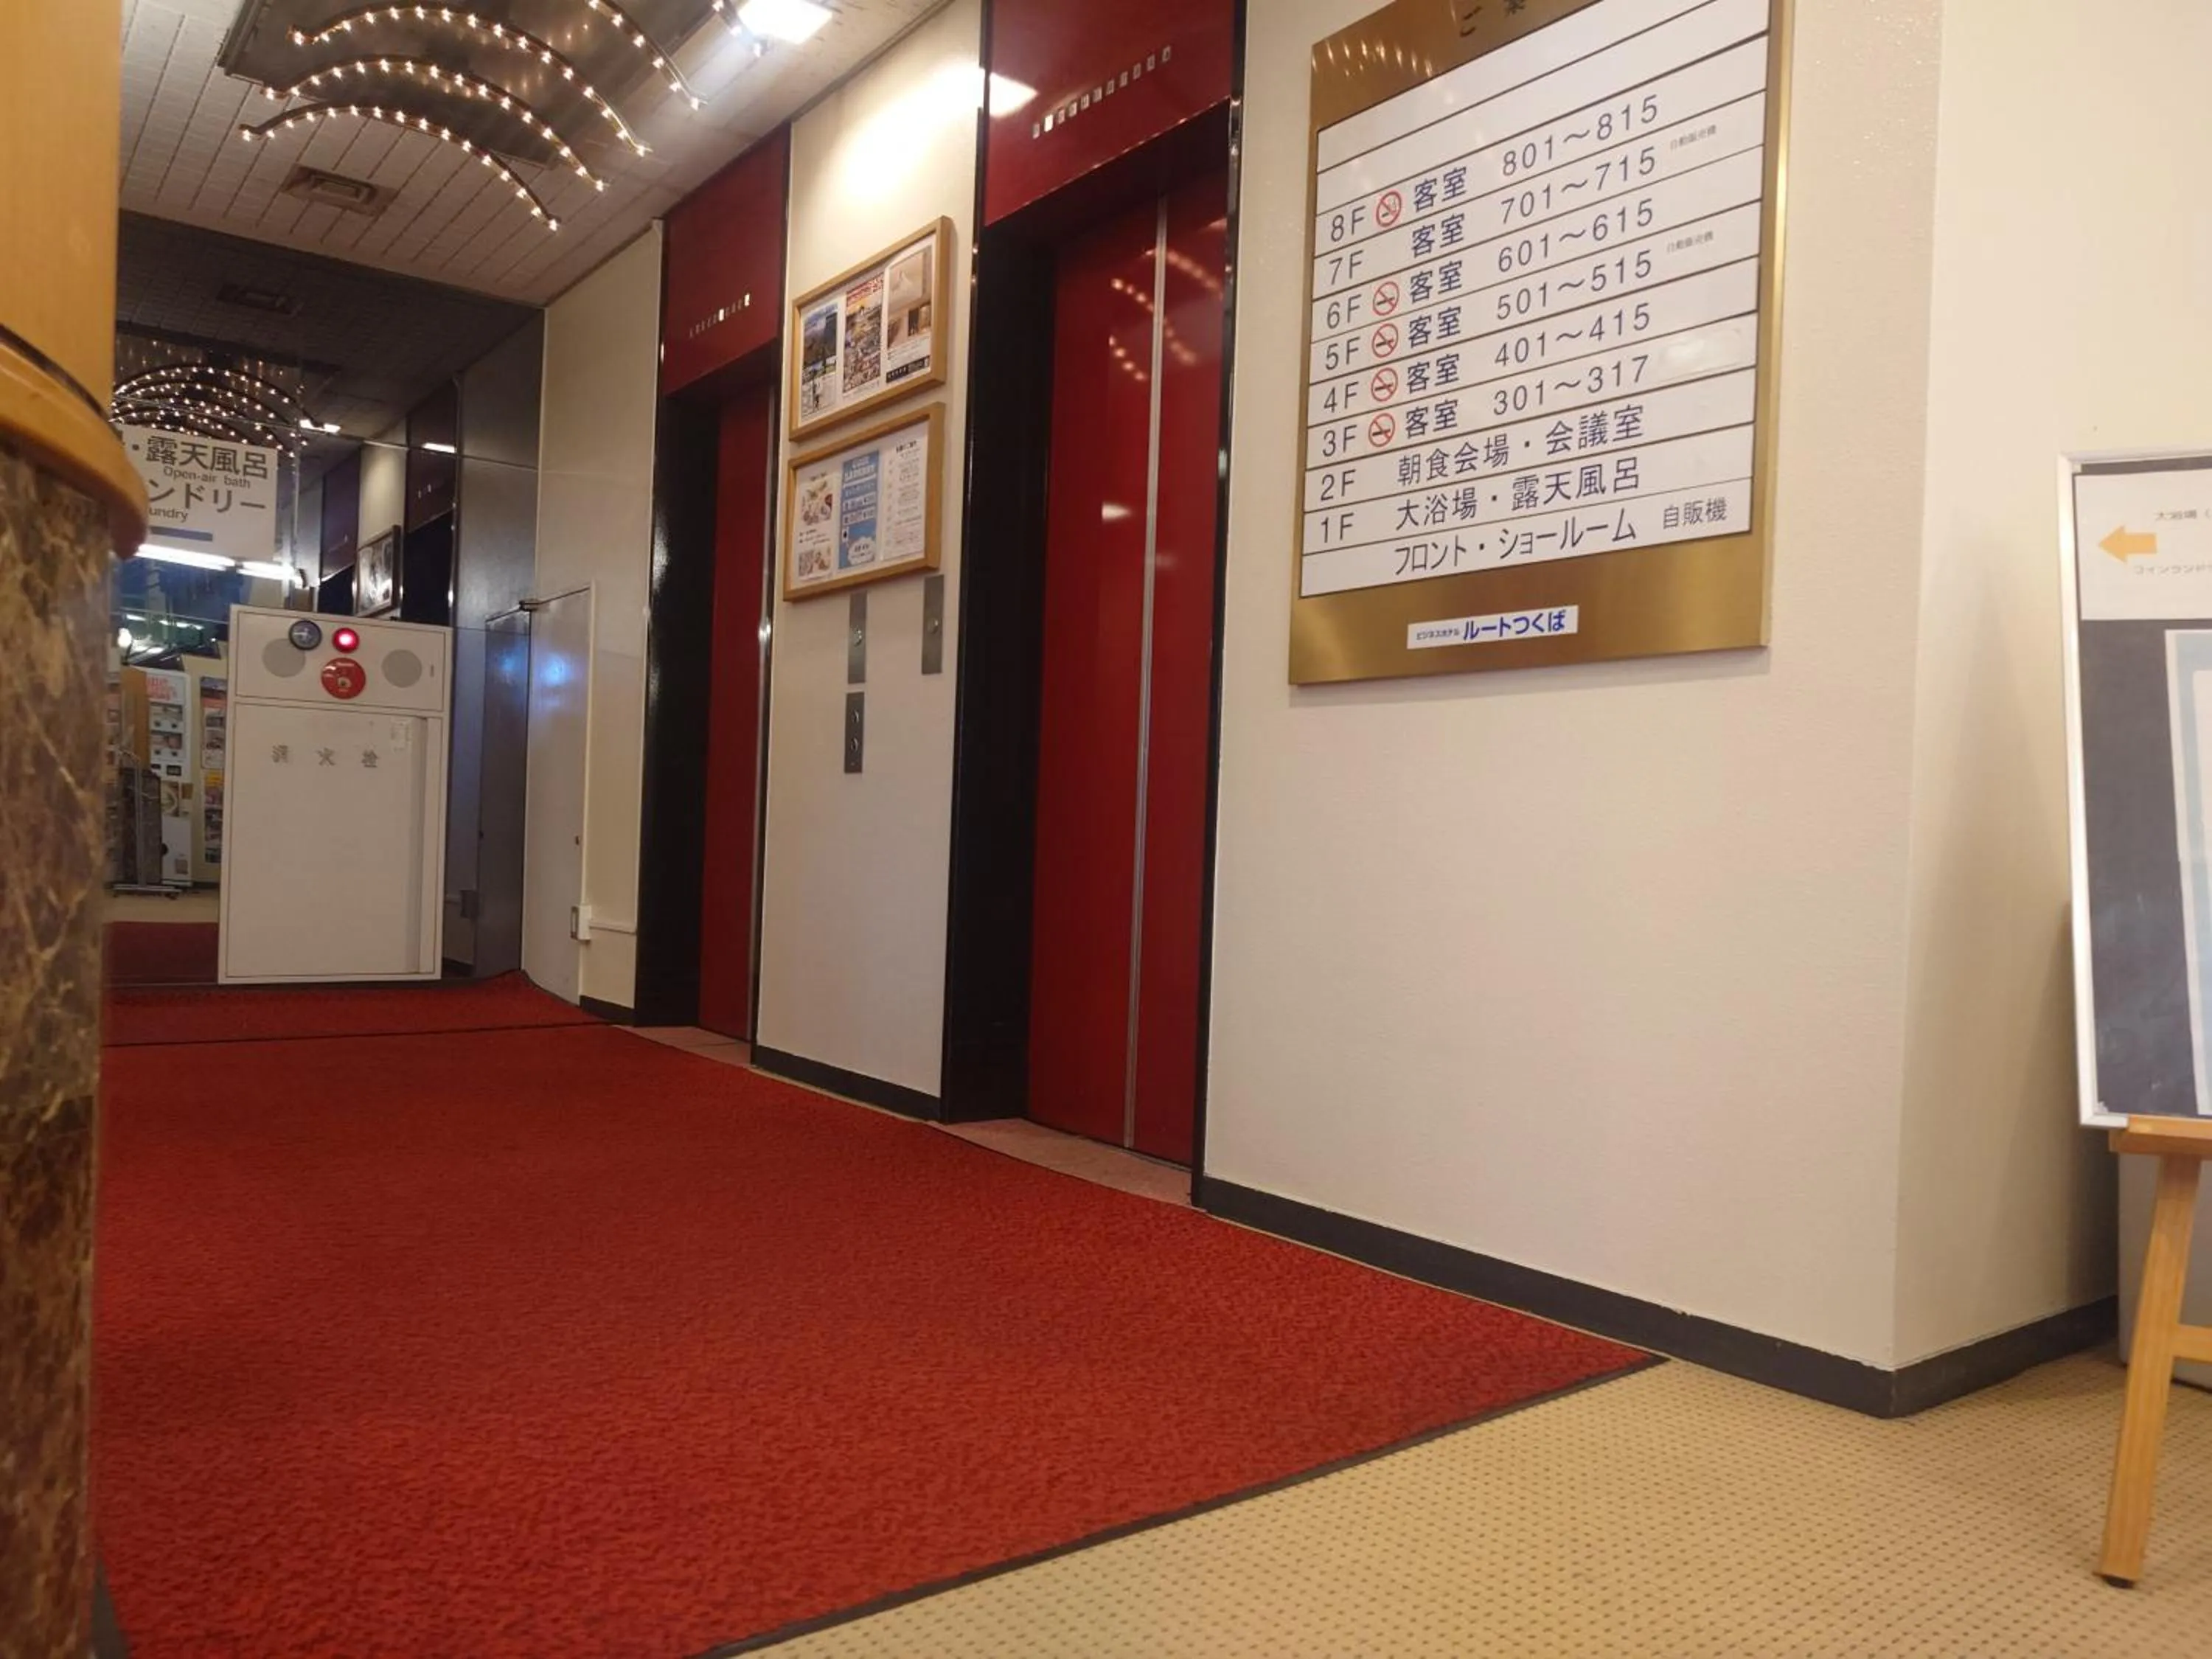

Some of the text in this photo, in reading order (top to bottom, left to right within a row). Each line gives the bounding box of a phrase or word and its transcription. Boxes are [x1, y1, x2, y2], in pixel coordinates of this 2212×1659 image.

[1330, 205, 1367, 243] 8F
[1413, 167, 1467, 213] 客室
[1329, 249, 1364, 285] 7F
[1411, 212, 1466, 259] 客室
[1327, 293, 1362, 330] 6F
[1410, 260, 1463, 305] 客室
[1326, 336, 1361, 371] 5F
[1408, 305, 1461, 349] 客室
[1324, 380, 1360, 414] 4F
[1407, 352, 1460, 395] 客室
[118, 430, 268, 479] ・露天風呂
[1320, 404, 1644, 502] 2F 朝食会場・会議室
[1323, 425, 1357, 458] 3F
[1405, 400, 1459, 439] 客室
[149, 479, 265, 512] ンドリー
[163, 465, 251, 489] Open-air bath
[1321, 456, 1639, 543] 1F 大浴場・露天風呂
[147, 506, 189, 523] undry
[1395, 497, 1727, 576] フロント・ショールーム 自販機
[1463, 609, 1566, 641] ルートつくば
